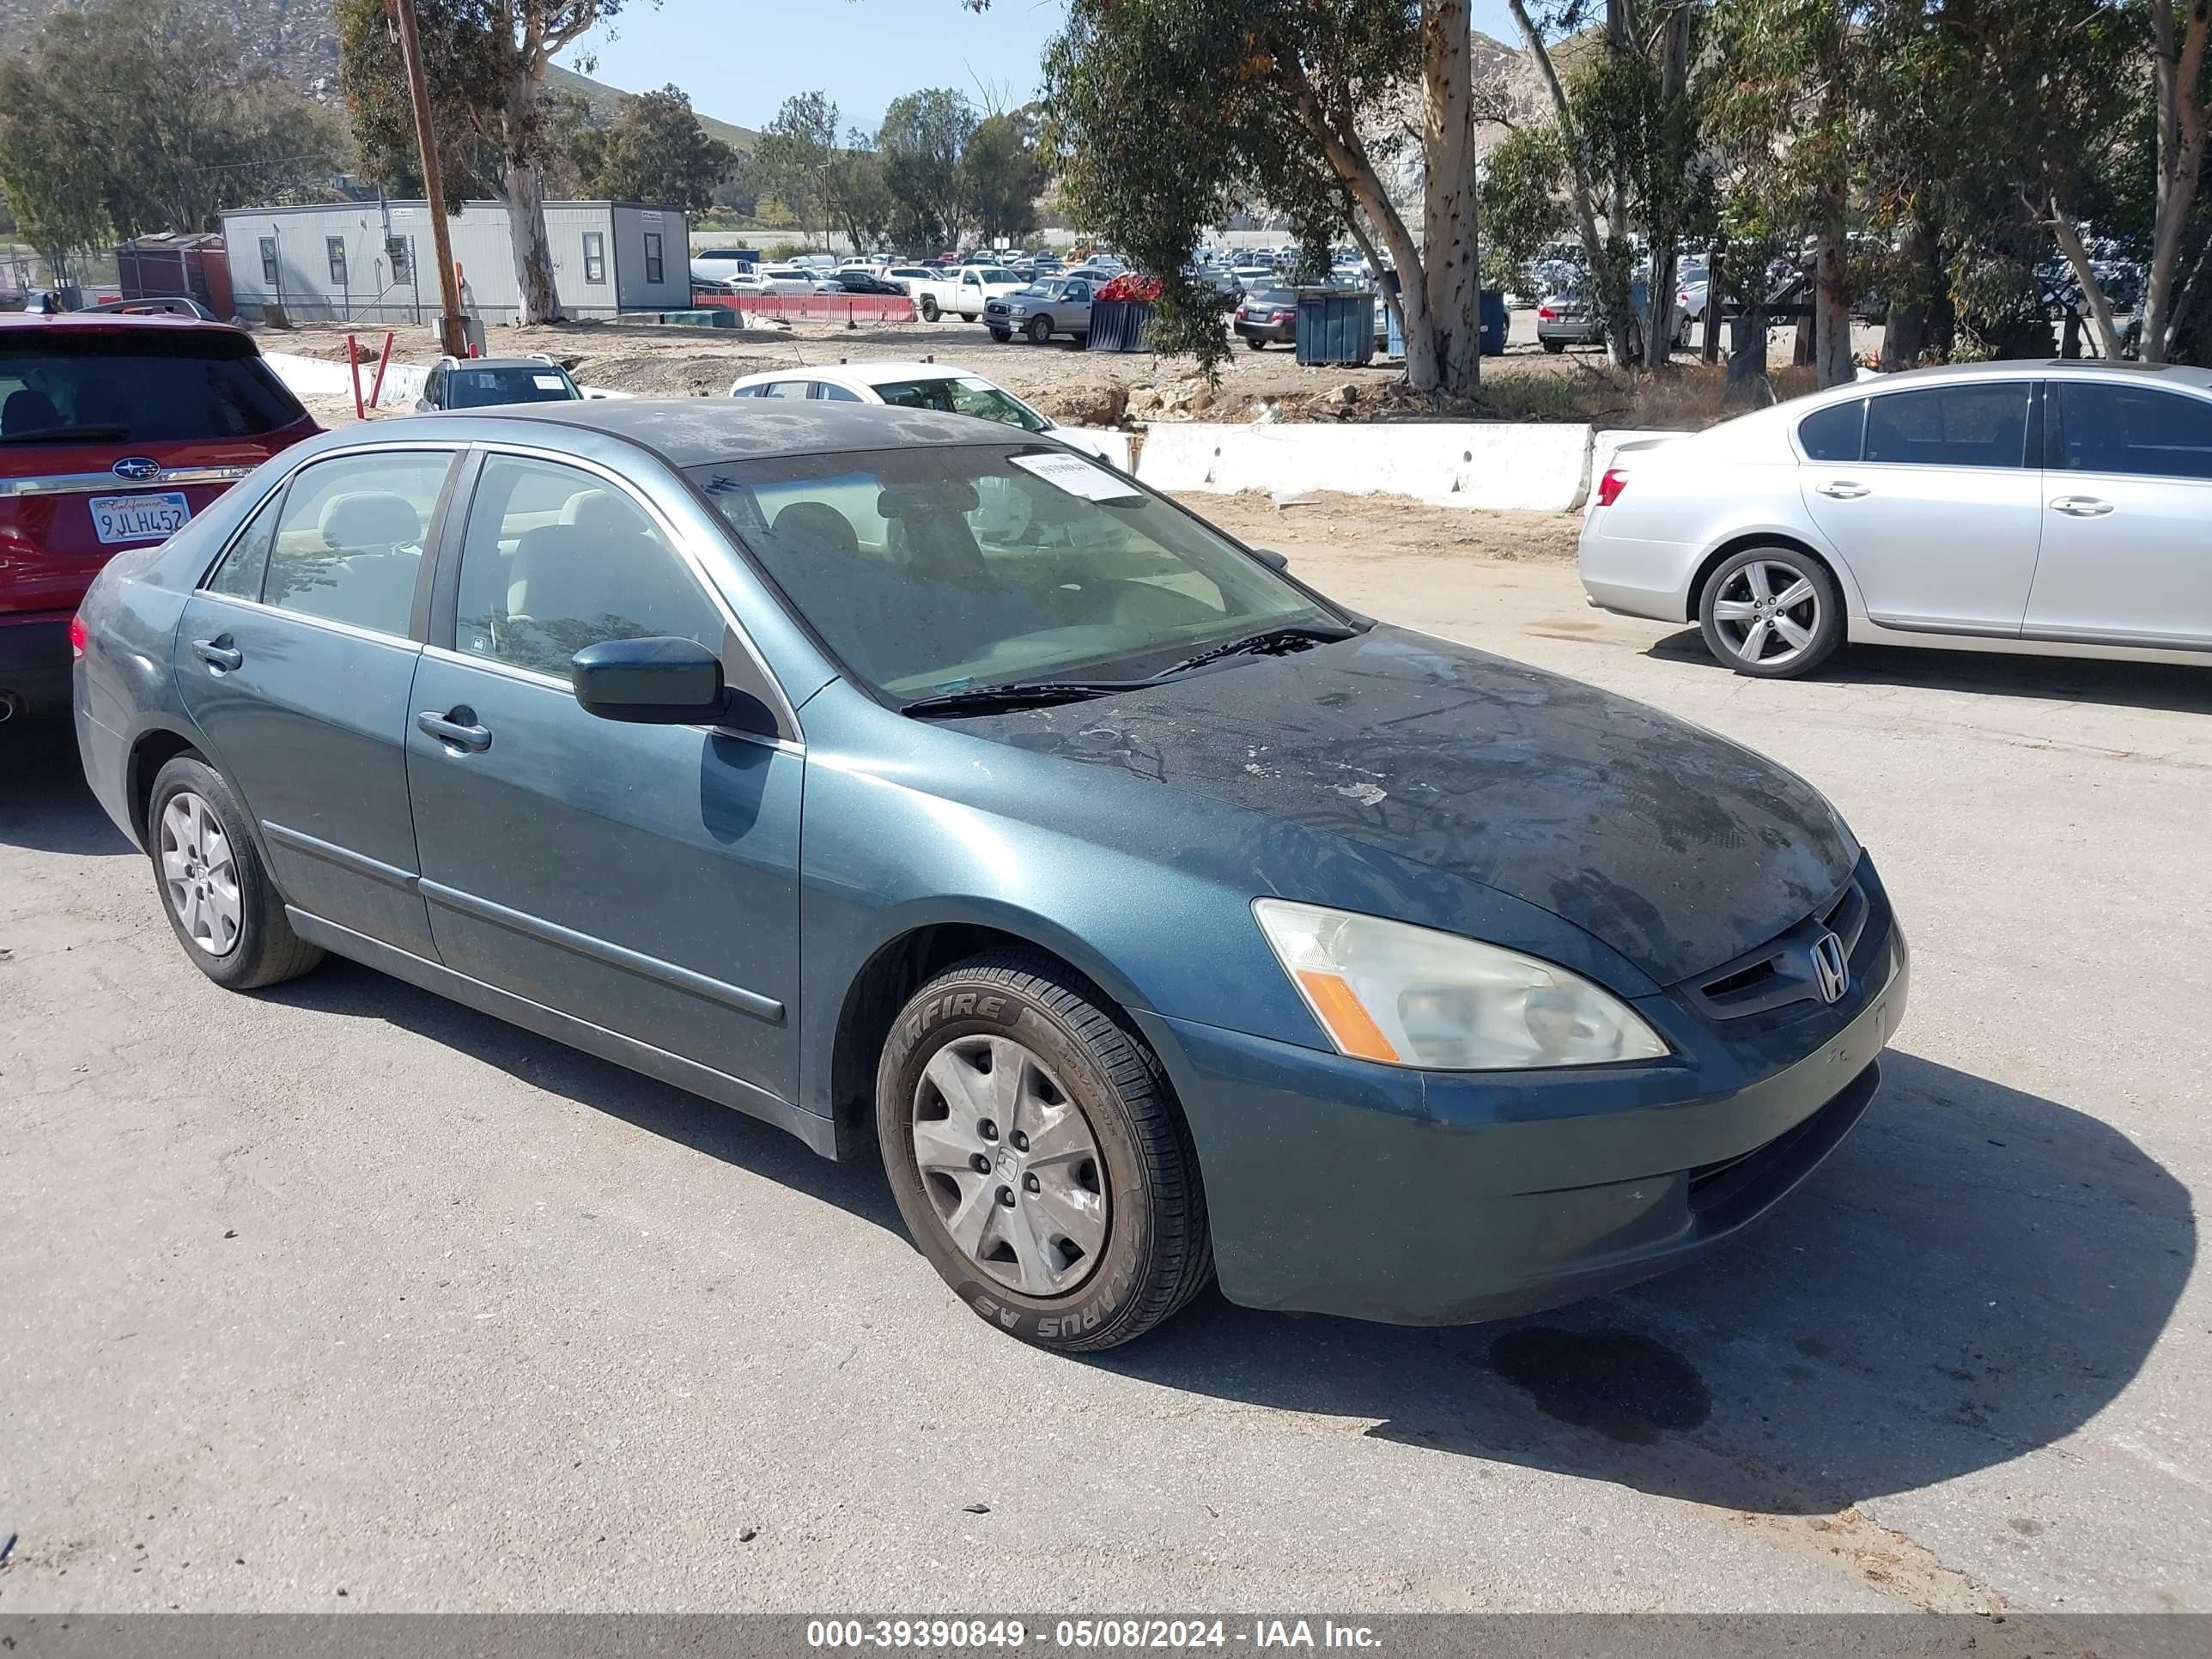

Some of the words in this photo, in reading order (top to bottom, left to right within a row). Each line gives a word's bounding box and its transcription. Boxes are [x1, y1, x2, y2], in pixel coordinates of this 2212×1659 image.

[109, 499, 167, 513] California
[101, 510, 182, 536] 9JLH452
[972, 1295, 1024, 1330] AS
